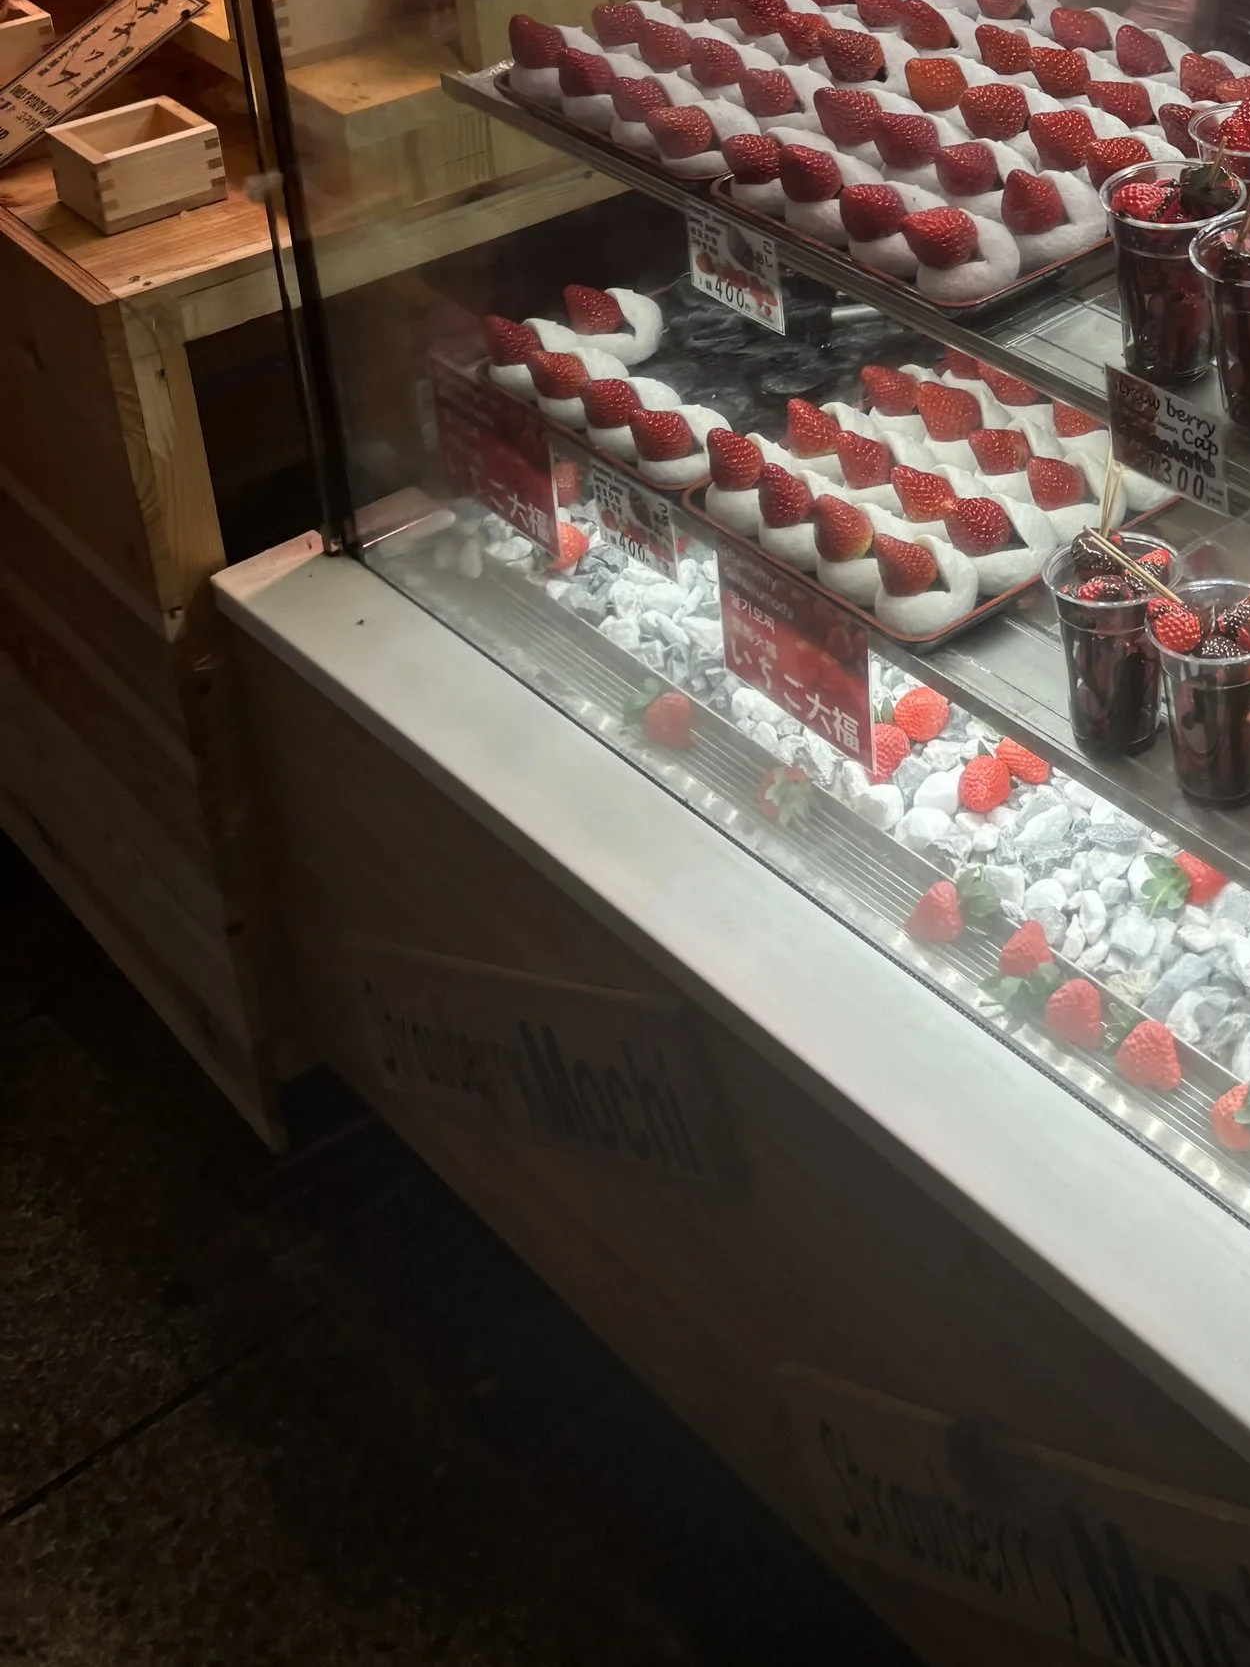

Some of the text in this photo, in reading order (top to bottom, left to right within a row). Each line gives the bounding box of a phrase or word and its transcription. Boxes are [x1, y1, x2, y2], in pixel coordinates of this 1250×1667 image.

[1181, 427, 1219, 463] Cap
[730, 638, 861, 755] いちご大福
